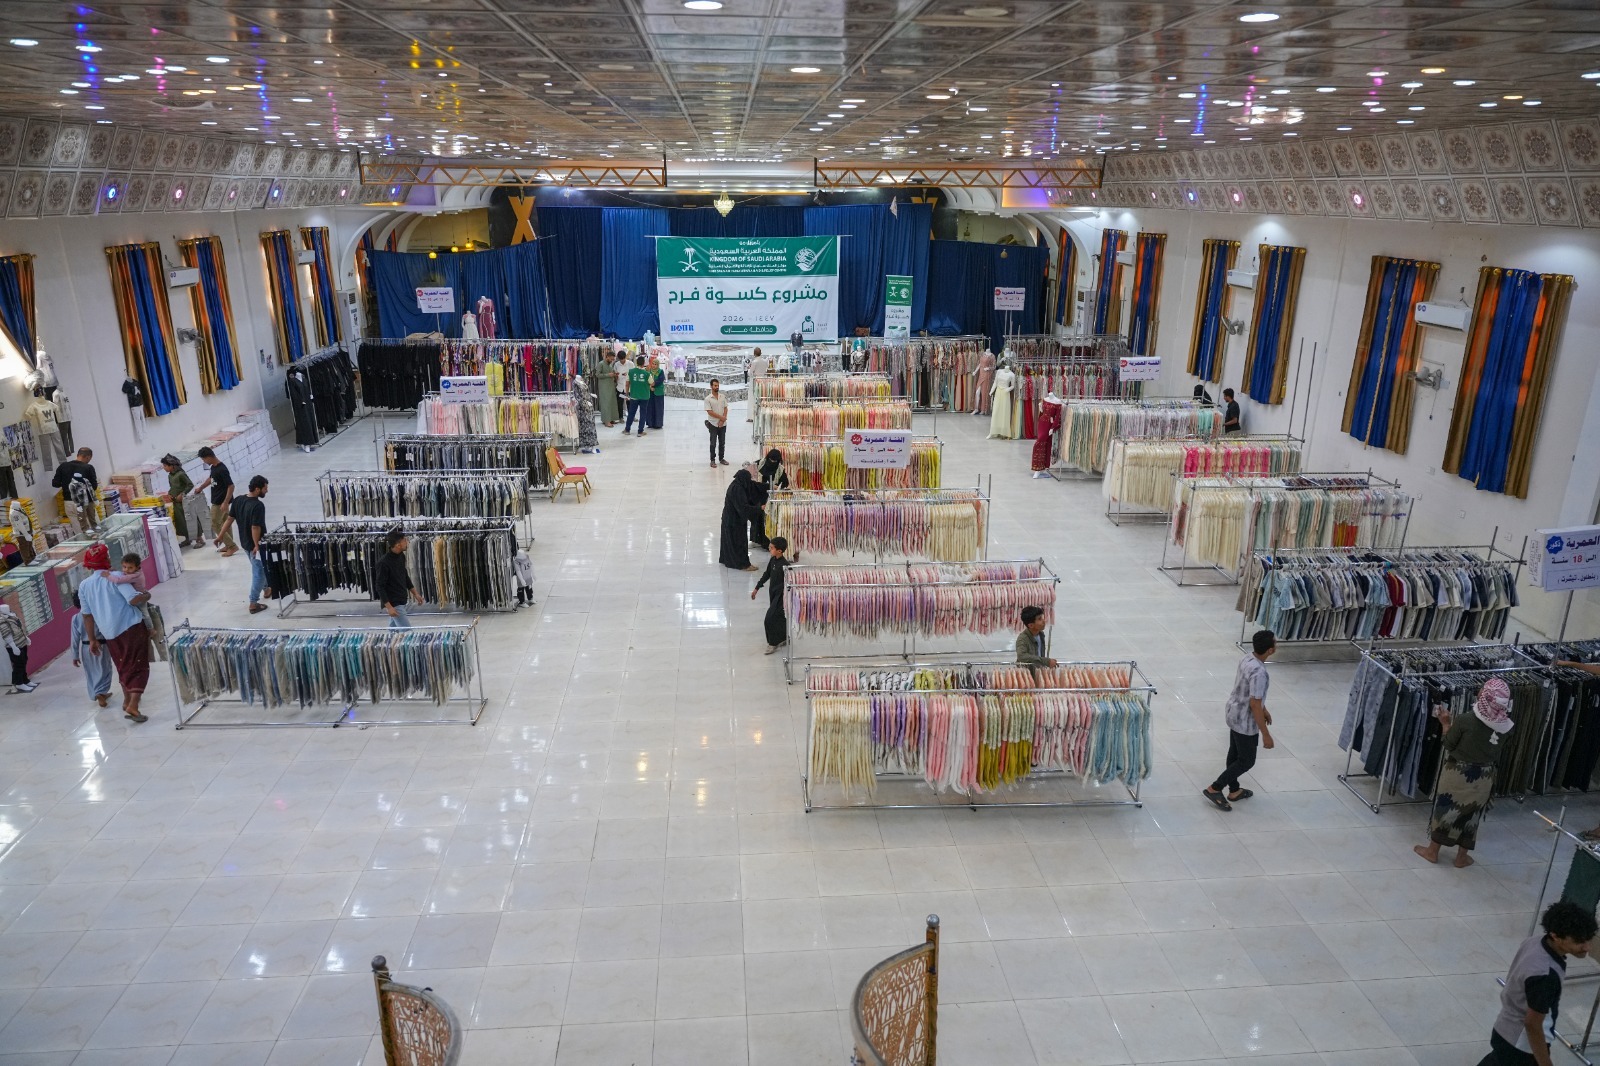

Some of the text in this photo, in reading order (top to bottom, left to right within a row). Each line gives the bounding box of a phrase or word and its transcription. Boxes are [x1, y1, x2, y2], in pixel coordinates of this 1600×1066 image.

[668, 284, 828, 304] مشروع كسوة فرح
[452, 380, 472, 388] العمرية
[864, 436, 888, 444] العمرية
[1551, 556, 1568, 564] سنة
[1572, 555, 1583, 563] 18
